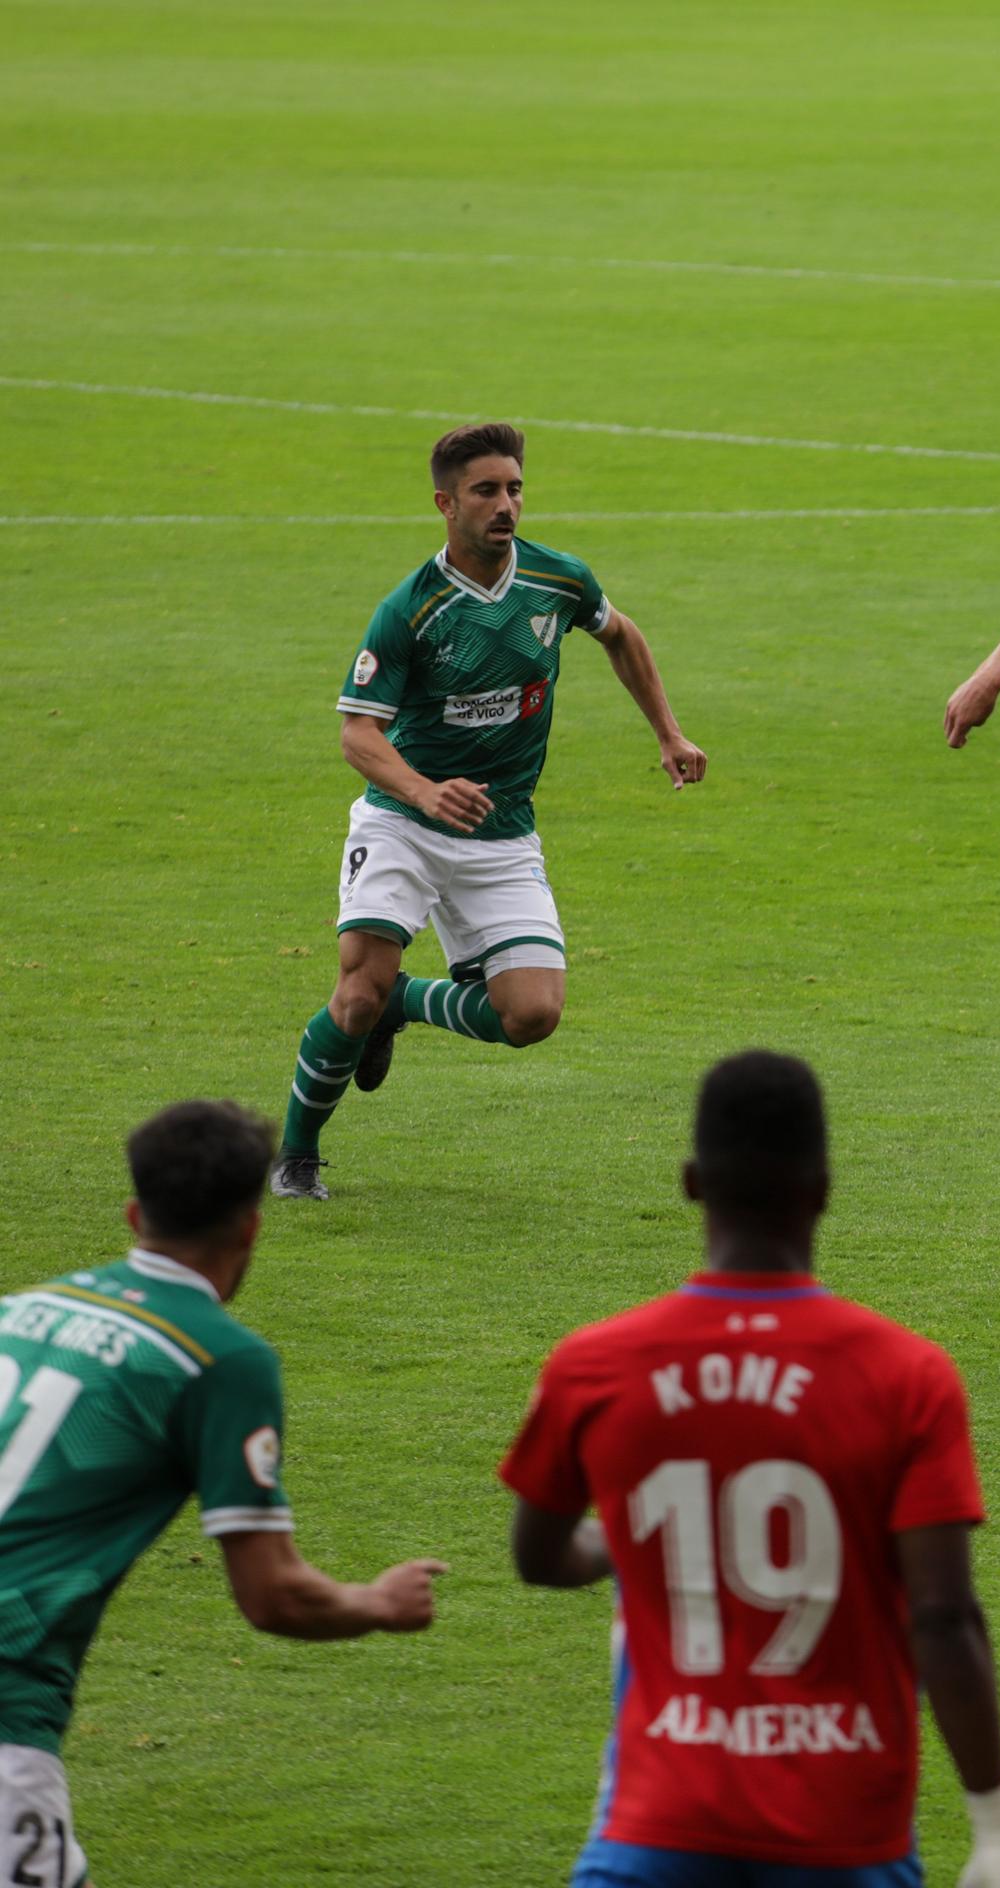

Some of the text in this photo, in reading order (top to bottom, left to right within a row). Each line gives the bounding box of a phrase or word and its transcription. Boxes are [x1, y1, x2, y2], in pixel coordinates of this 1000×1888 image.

[476, 706, 505, 719] VIGO
[347, 846, 368, 886] 9
[650, 1352, 814, 1416] KONE
[0, 1353, 84, 1521] 1
[626, 1458, 843, 1677] 19
[646, 1693, 885, 1757] ALMERKA
[9, 1811, 66, 1888] 21
